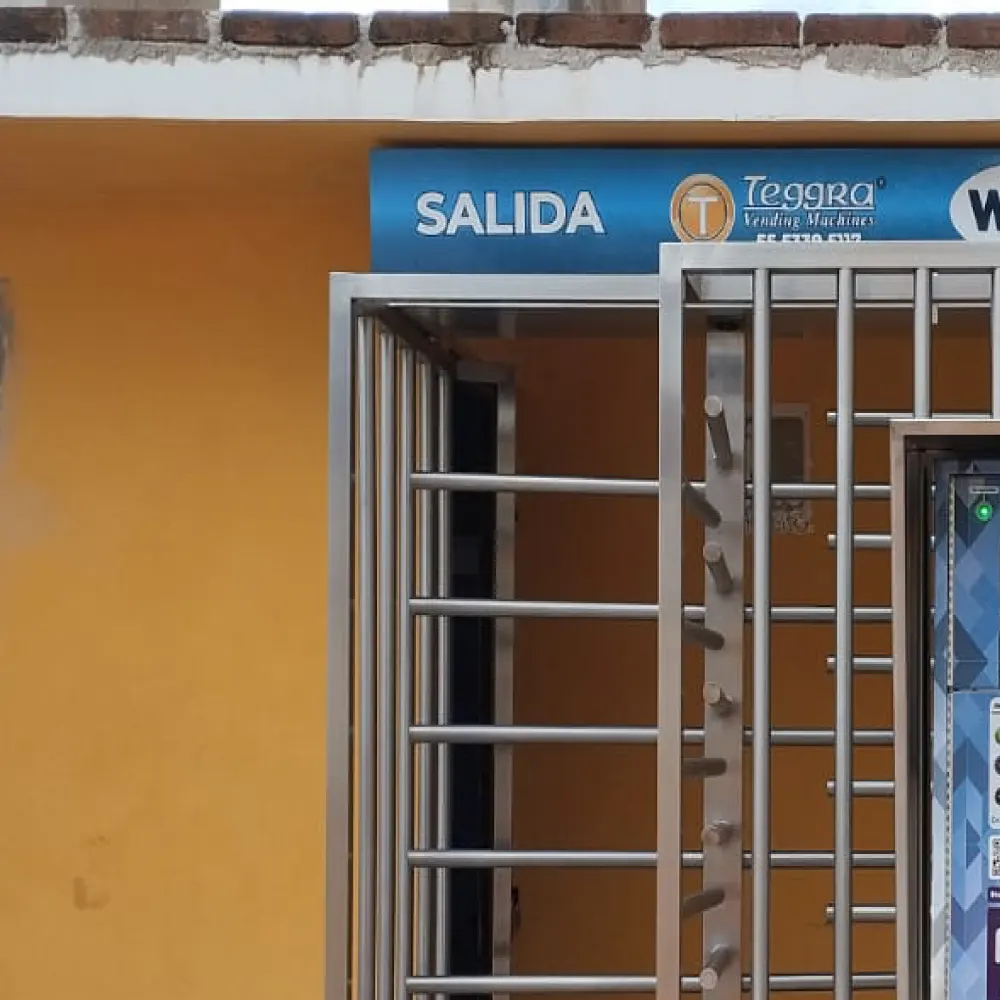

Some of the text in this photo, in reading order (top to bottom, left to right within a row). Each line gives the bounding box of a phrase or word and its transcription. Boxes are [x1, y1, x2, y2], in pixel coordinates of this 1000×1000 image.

[415, 190, 606, 236] SALIDA
[743, 211, 875, 231] Vending Machines
